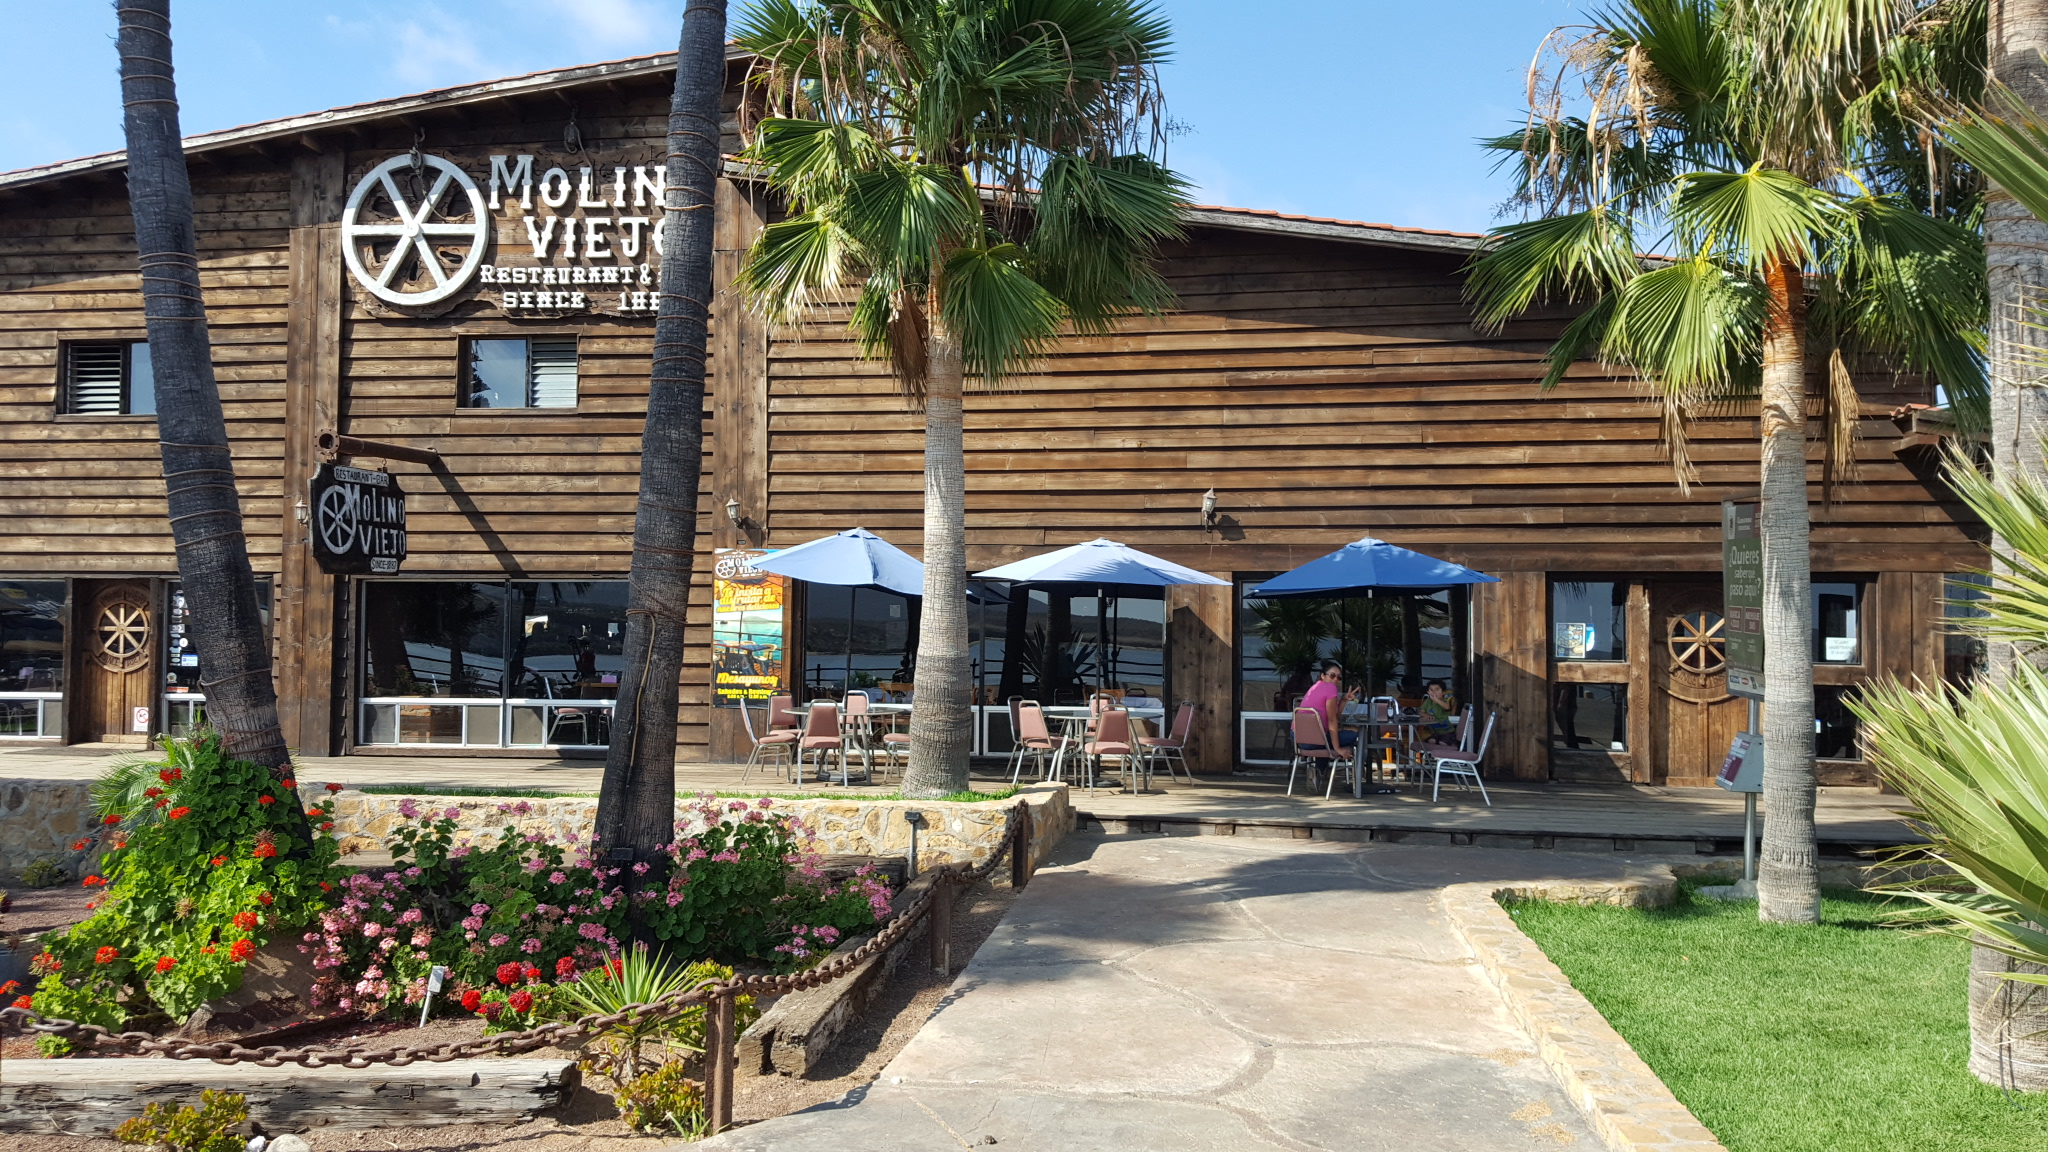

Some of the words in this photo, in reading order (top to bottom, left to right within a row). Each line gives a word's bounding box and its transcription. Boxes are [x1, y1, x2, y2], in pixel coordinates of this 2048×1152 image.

[488, 155, 666, 210] MOLIN
[502, 291, 587, 309] SINCE
[344, 482, 406, 525] MOLINO
[358, 524, 406, 556] VIEJO
[1729, 544, 1760, 568] ¿Quieres
[1734, 566, 1748, 579] saber
